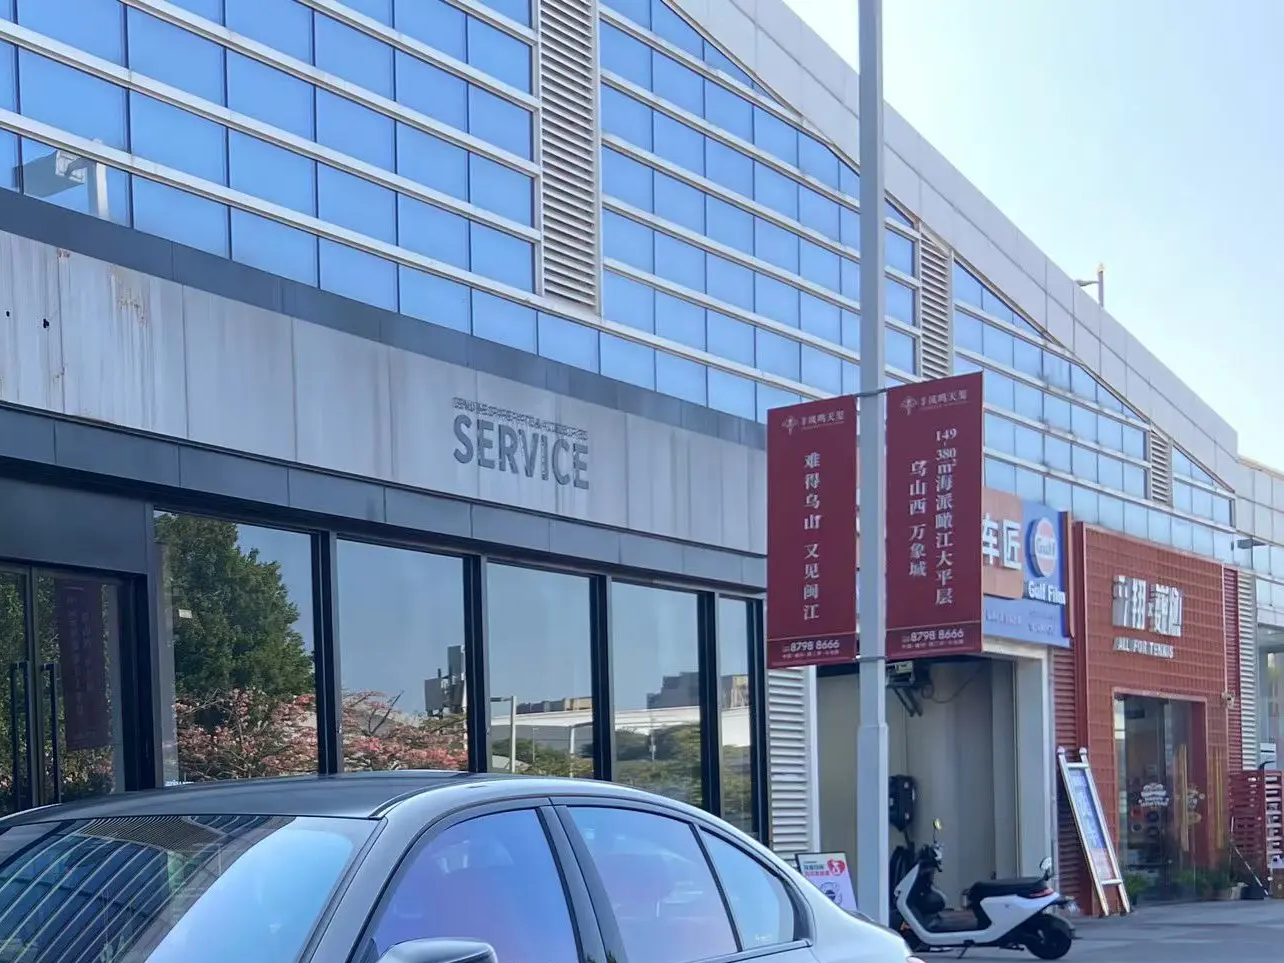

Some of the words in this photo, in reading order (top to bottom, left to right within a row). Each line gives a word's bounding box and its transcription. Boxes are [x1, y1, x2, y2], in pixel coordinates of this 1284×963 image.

[453, 415, 589, 490] SERVICE
[804, 452, 822, 530] 难得乌山
[909, 460, 928, 515] 乌山西
[909, 524, 927, 577] 万象城
[982, 513, 1021, 570] 车匠
[803, 543, 820, 620] 又见闽江
[1028, 581, 1045, 600] Gulf
[1047, 584, 1066, 605] Film
[790, 641, 813, 651] 8798
[815, 639, 840, 650] 8666
[910, 630, 936, 642] 8798
[938, 628, 964, 640] 8666
[1116, 637, 1130, 651] ALL
[1133, 639, 1147, 654] FOR
